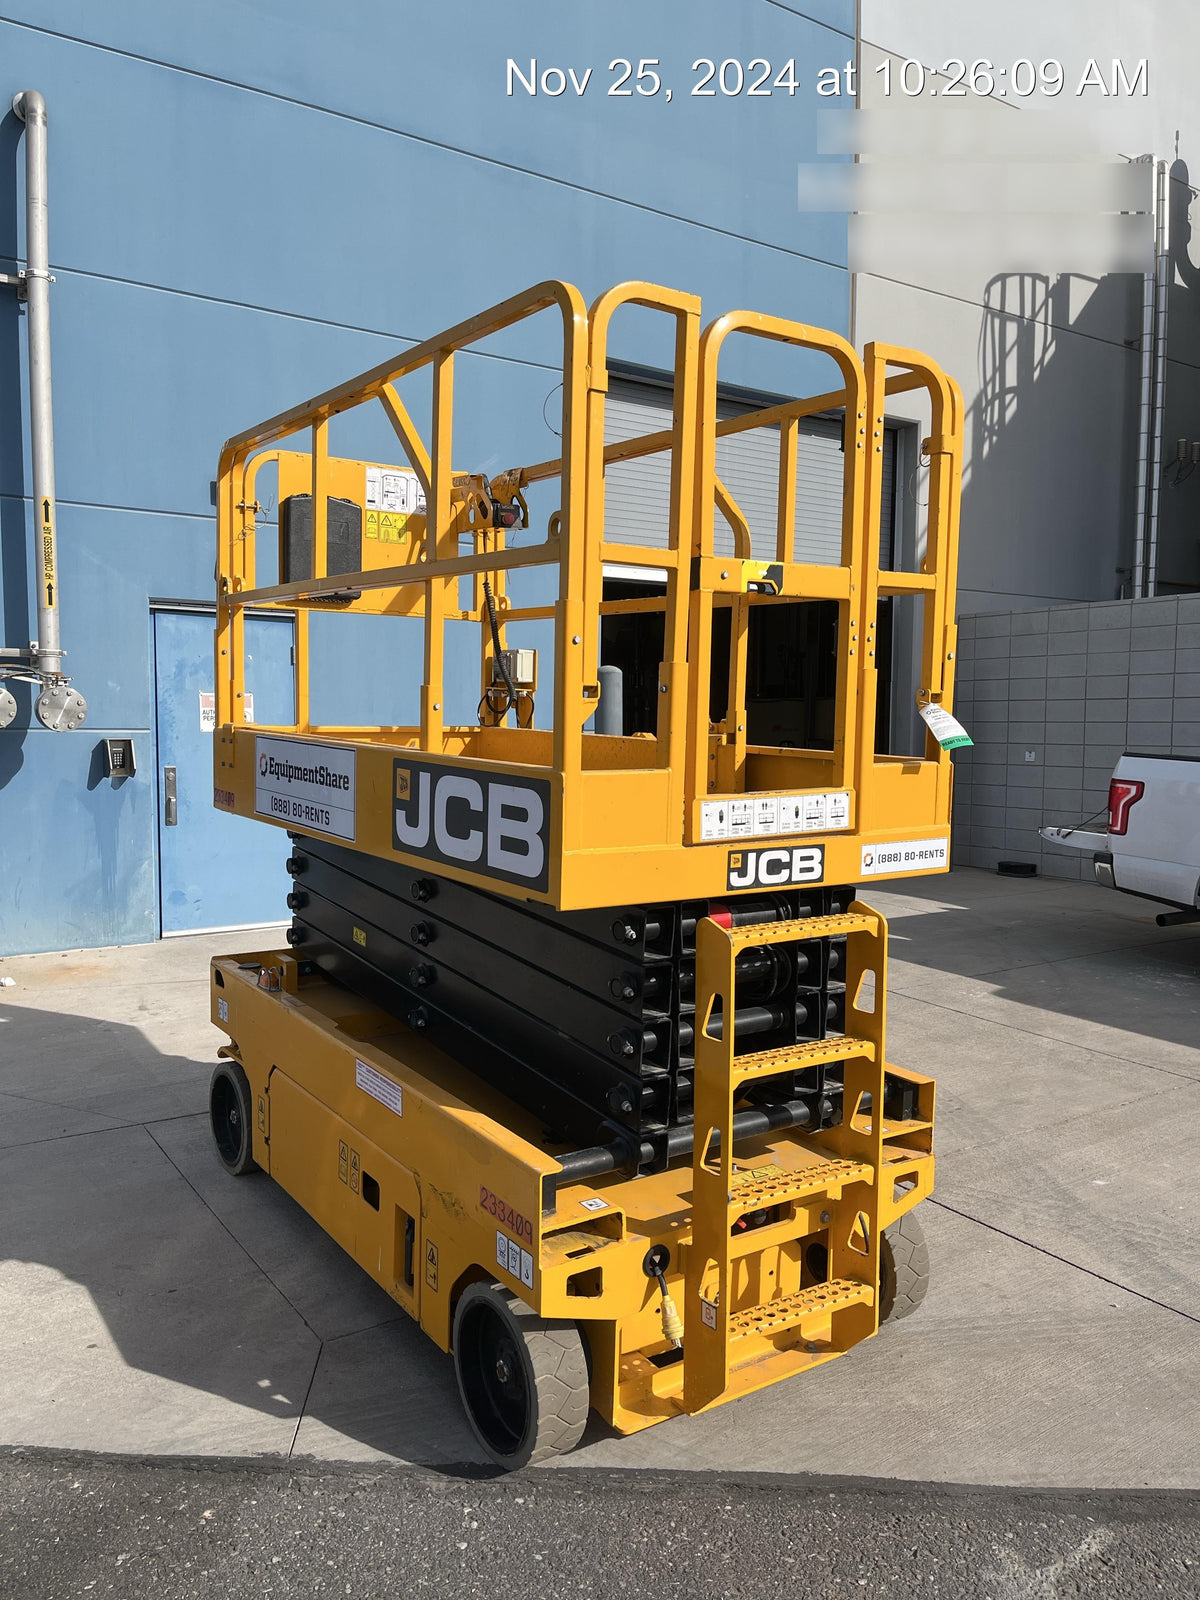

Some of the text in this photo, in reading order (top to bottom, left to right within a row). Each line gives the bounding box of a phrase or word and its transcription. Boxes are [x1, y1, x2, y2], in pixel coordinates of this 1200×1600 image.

[43, 526, 51, 535] AIR
[44, 536, 53, 571] COMPRESSED
[268, 757, 350, 791] EquipmentShare
[271, 795, 330, 826] (888) 80-RENTS
[395, 771, 544, 878] JCB
[729, 847, 823, 887] JCB
[877, 848, 945, 865] (888) 80-RENTS
[480, 1186, 533, 1246] 233409
